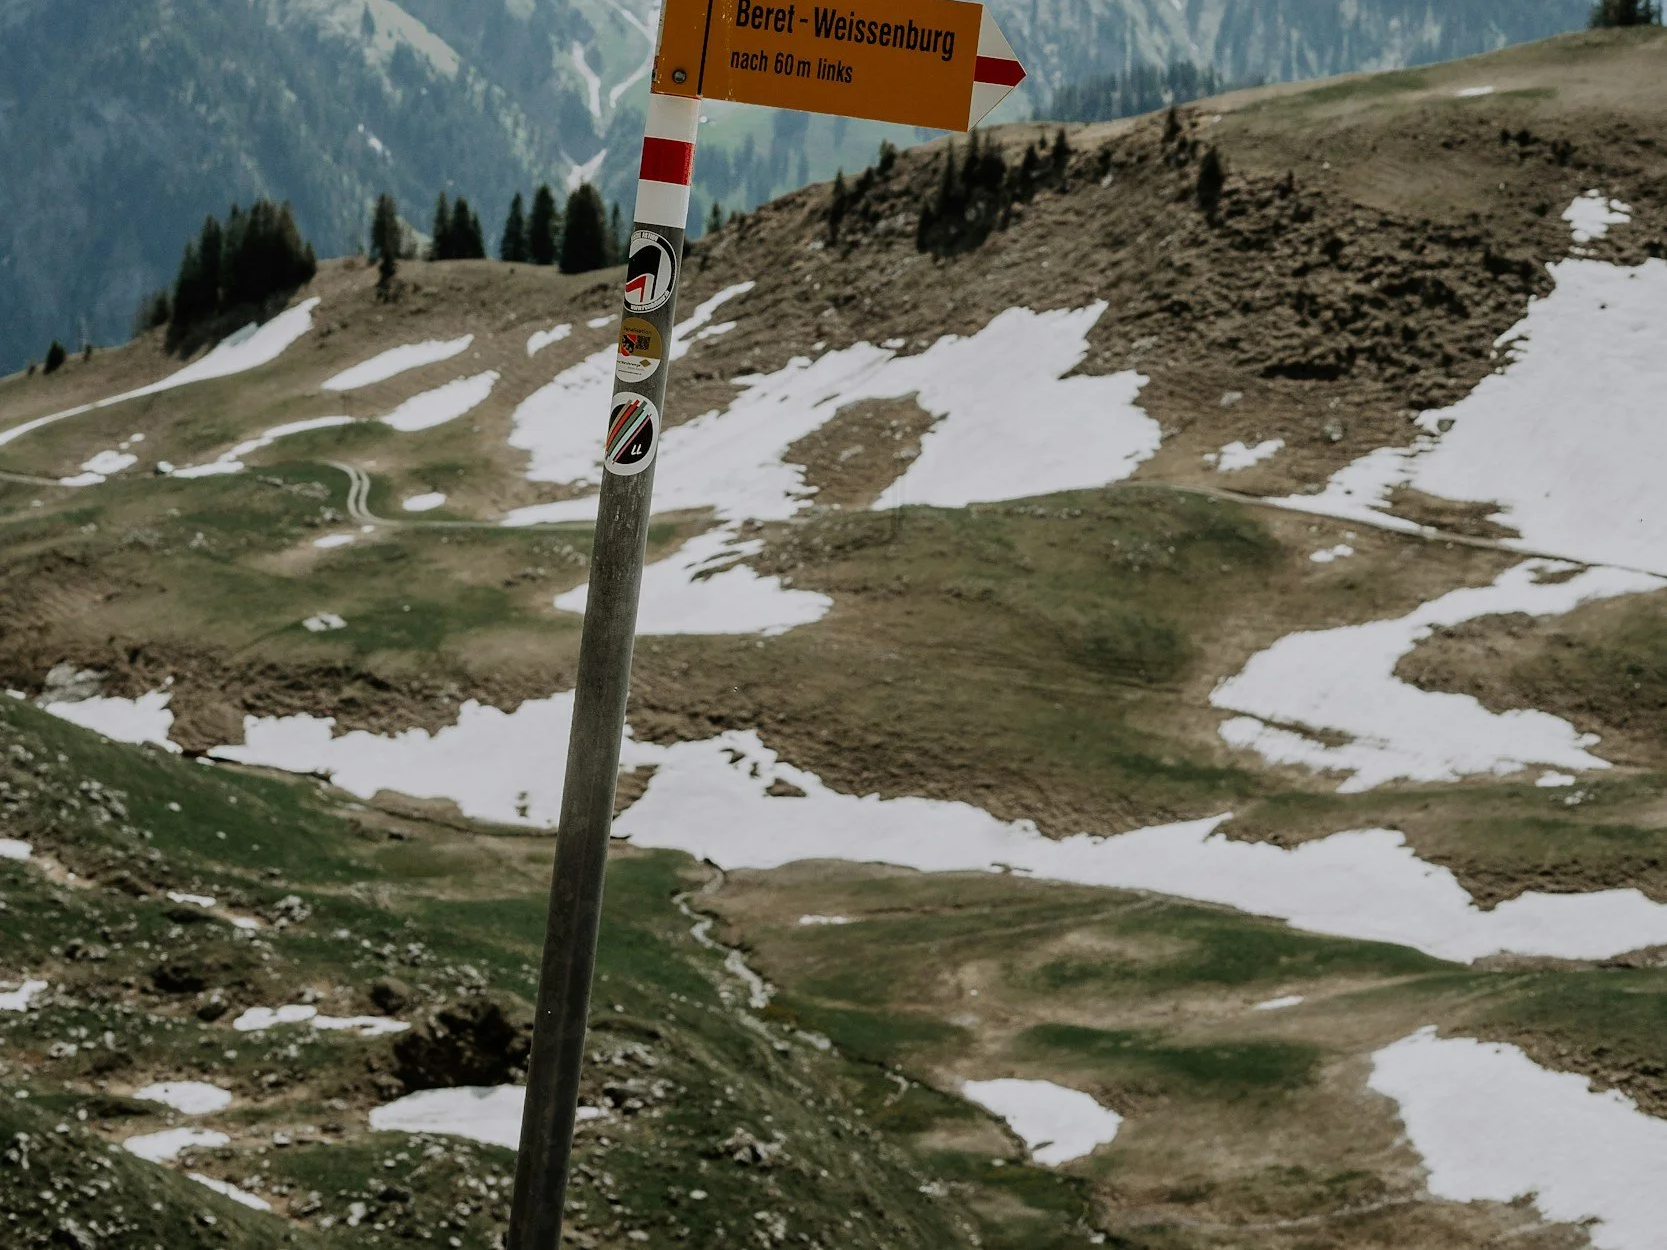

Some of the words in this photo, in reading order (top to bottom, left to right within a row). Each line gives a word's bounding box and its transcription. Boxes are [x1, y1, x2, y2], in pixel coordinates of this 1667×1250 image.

[814, 6, 956, 62] Weissenburg
[730, 50, 768, 72] nach
[817, 57, 853, 83] links
